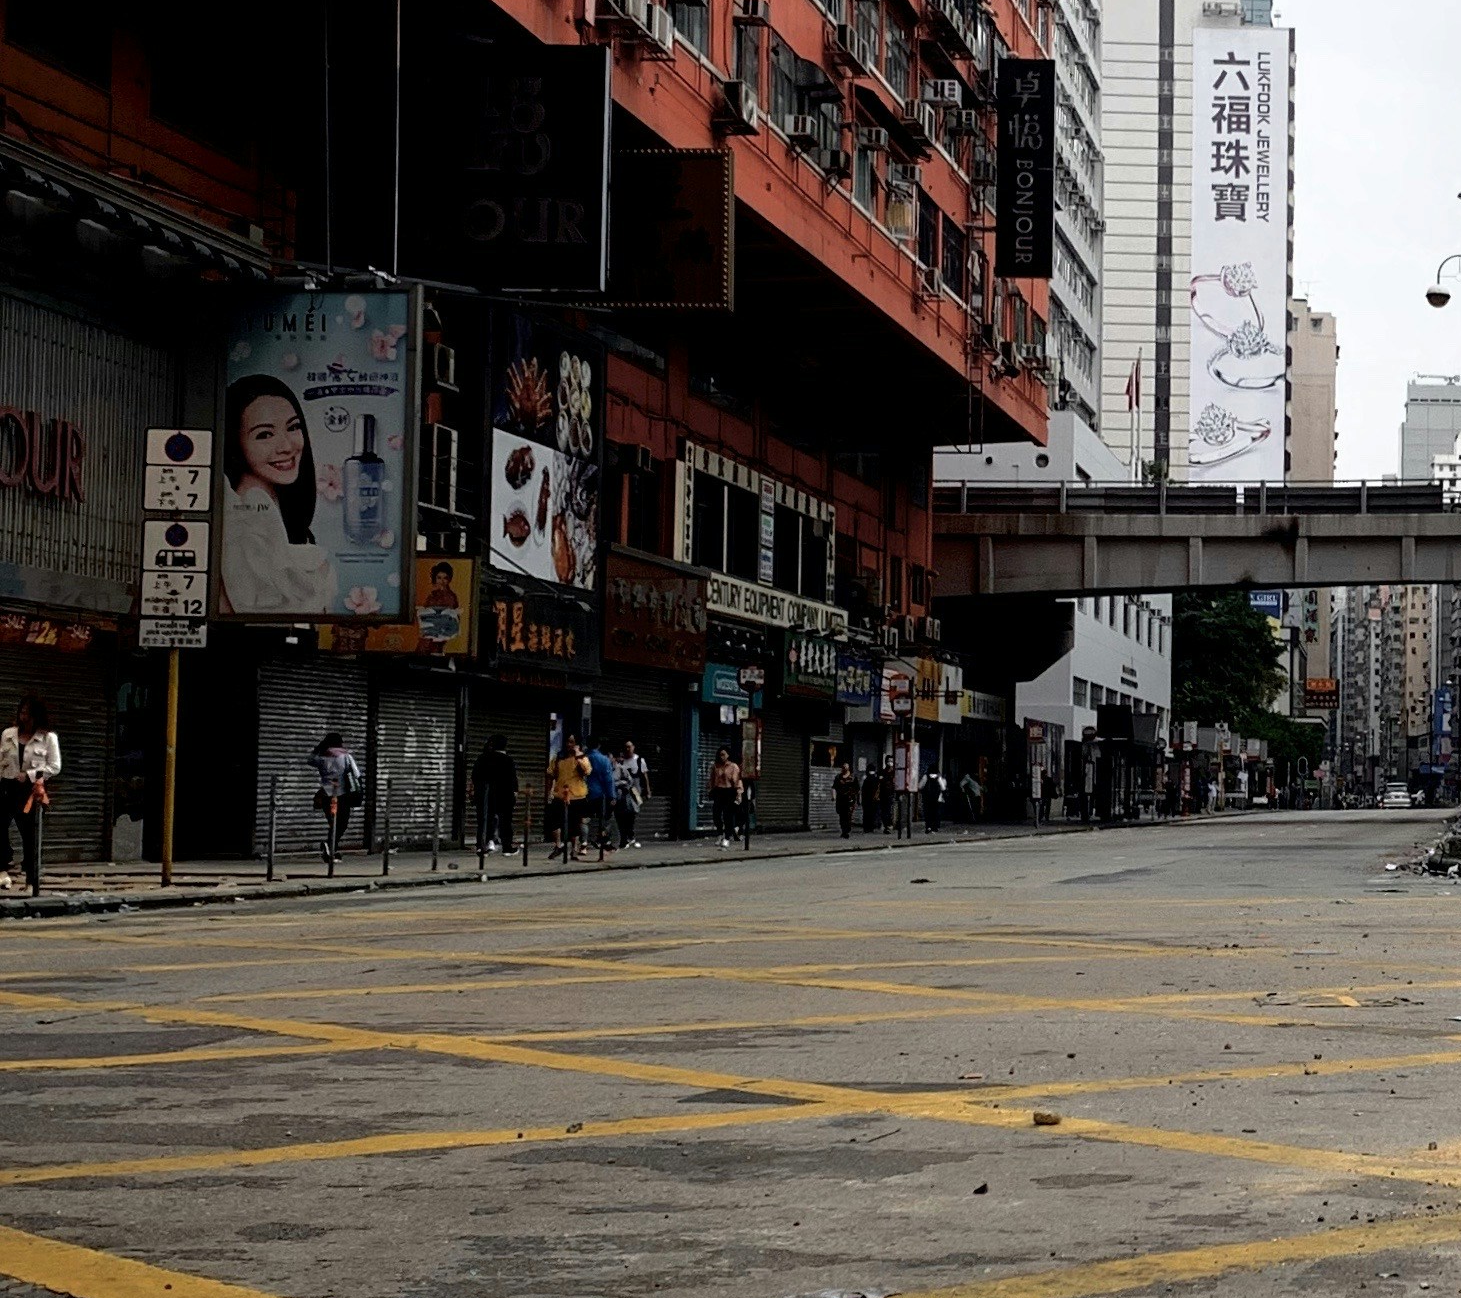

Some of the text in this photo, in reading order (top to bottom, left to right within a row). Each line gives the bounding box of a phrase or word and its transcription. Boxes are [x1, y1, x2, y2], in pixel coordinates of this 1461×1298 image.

[1211, 51, 1251, 223] 六福珠寶
[1256, 52, 1270, 223] LUKFOOK JEWELLERY
[1013, 159, 1034, 264] BONJOUR
[188, 470, 199, 485] 7
[187, 493, 198, 508] 7
[183, 575, 194, 590] 7
[144, 596, 179, 605] midnight
[706, 577, 741, 610] CENTURY
[182, 599, 203, 615] 12
